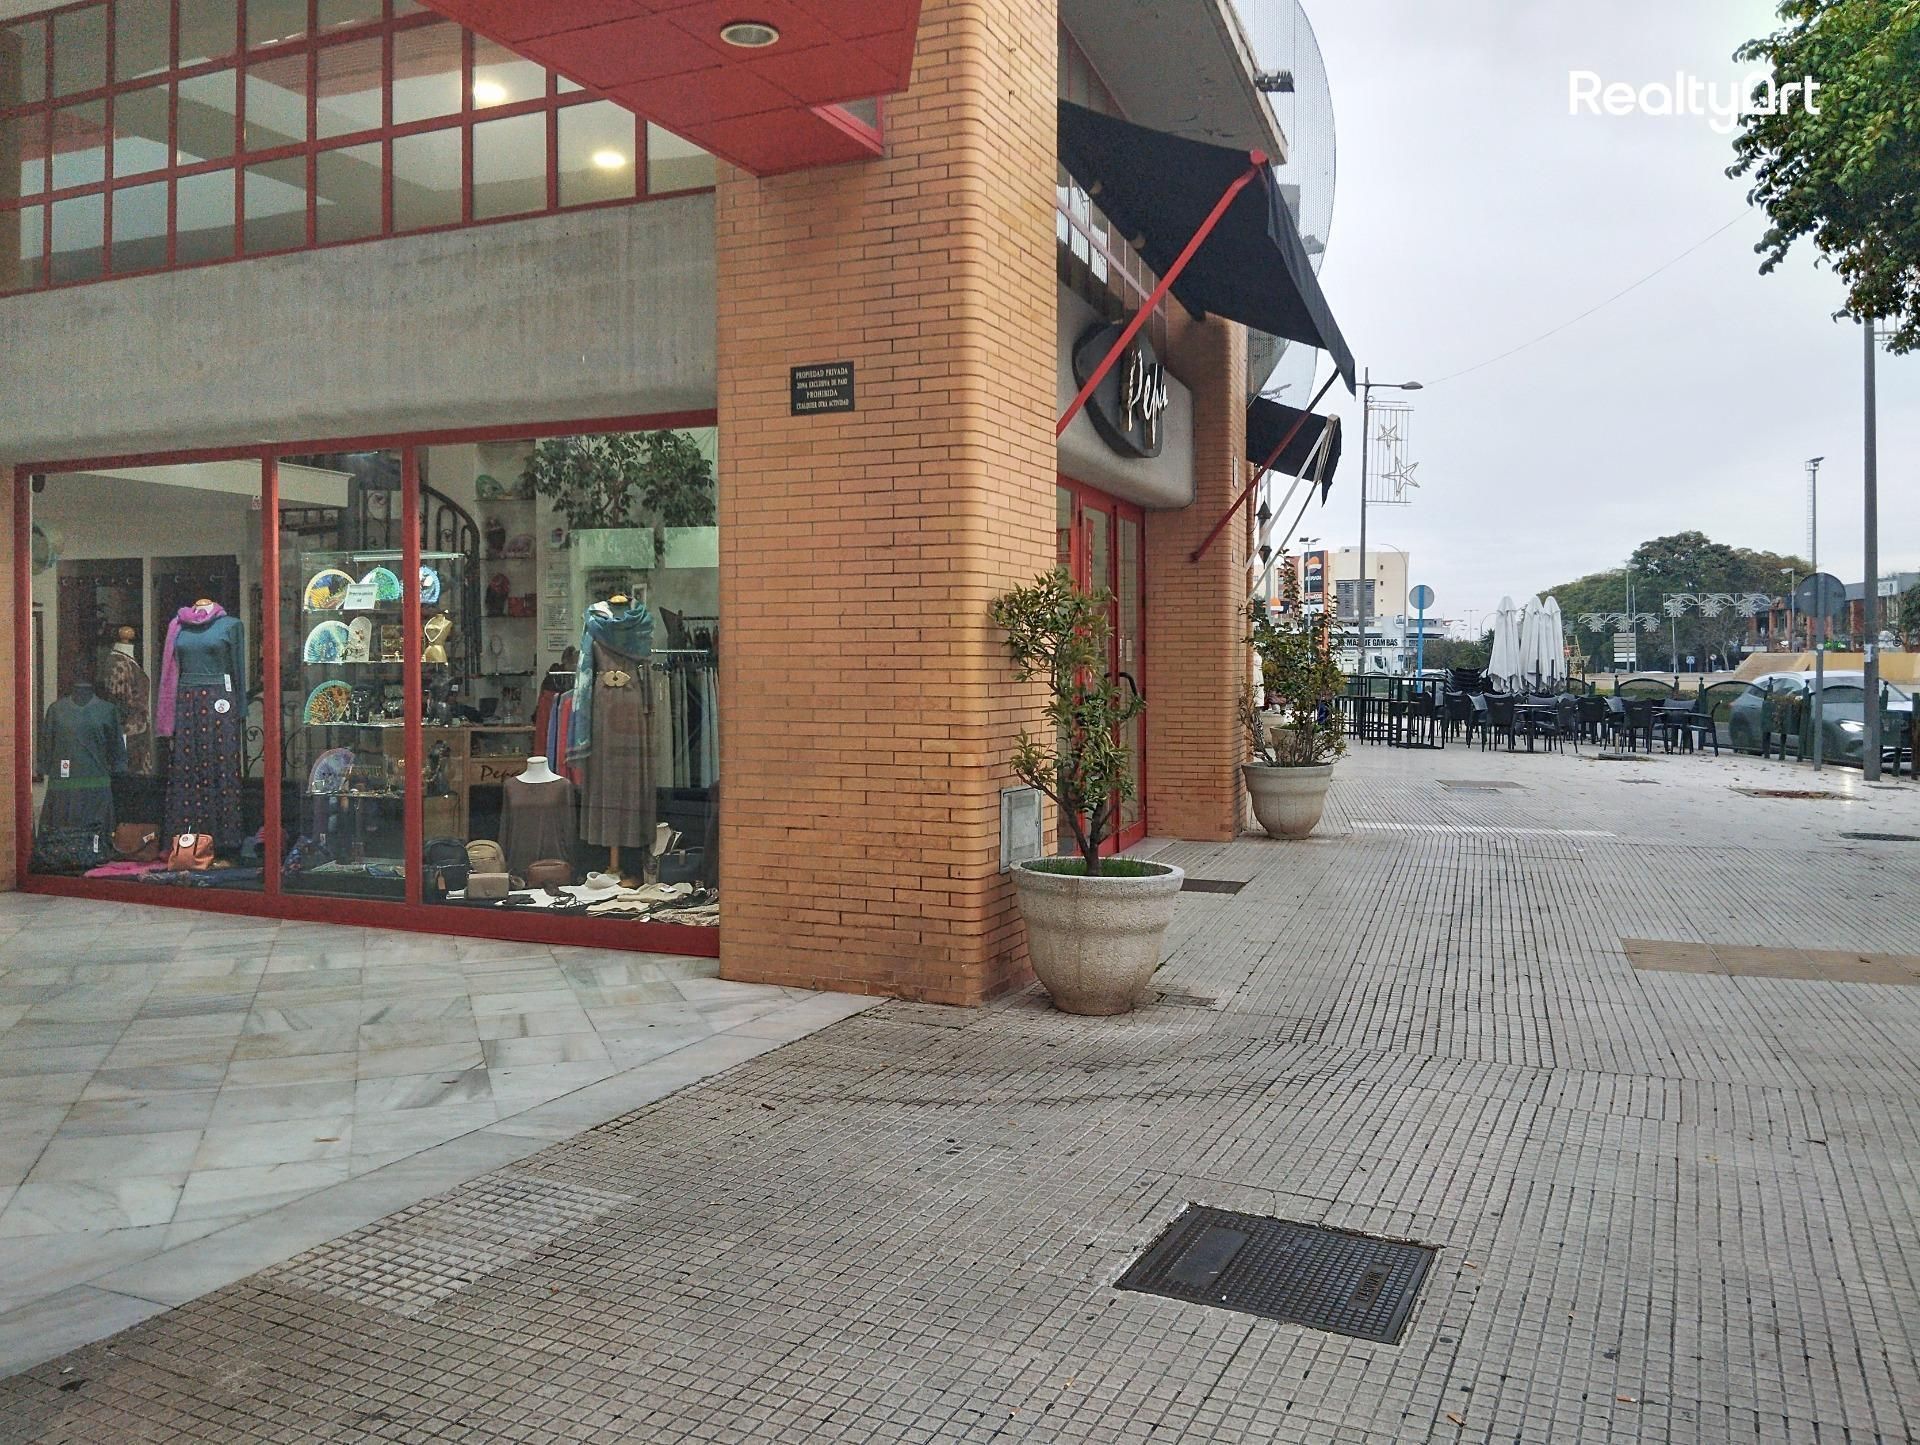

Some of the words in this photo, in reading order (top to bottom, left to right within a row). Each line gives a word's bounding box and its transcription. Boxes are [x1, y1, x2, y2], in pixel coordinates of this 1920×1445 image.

[796, 370, 824, 379] PROPIEDAD
[825, 368, 848, 376] PRIVADA
[806, 389, 838, 398] PROHIBIDA
